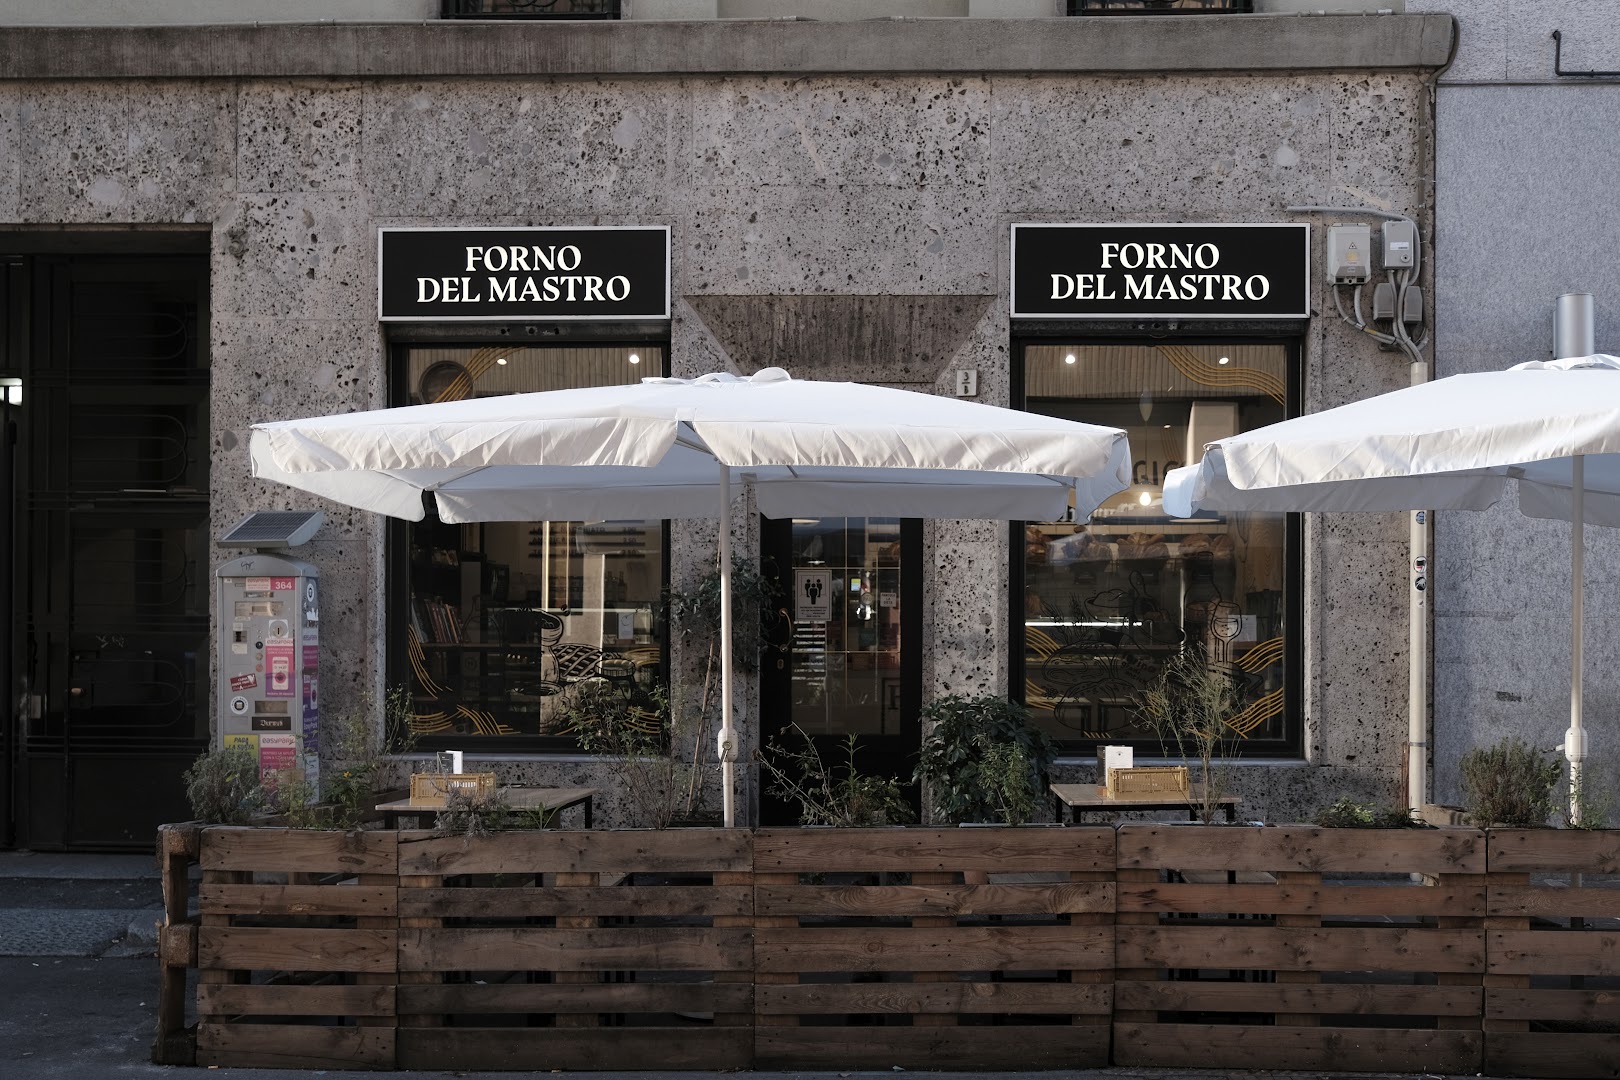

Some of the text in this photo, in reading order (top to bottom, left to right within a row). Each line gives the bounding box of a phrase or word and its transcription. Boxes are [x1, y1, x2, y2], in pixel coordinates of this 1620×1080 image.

[465, 244, 582, 272] FORNO
[1100, 242, 1220, 270] FORNO
[416, 275, 631, 303] DEL MASTRO
[1050, 273, 1270, 301] DEL MASTRO
[963, 371, 969, 381] 3
[275, 581, 292, 590] 364
